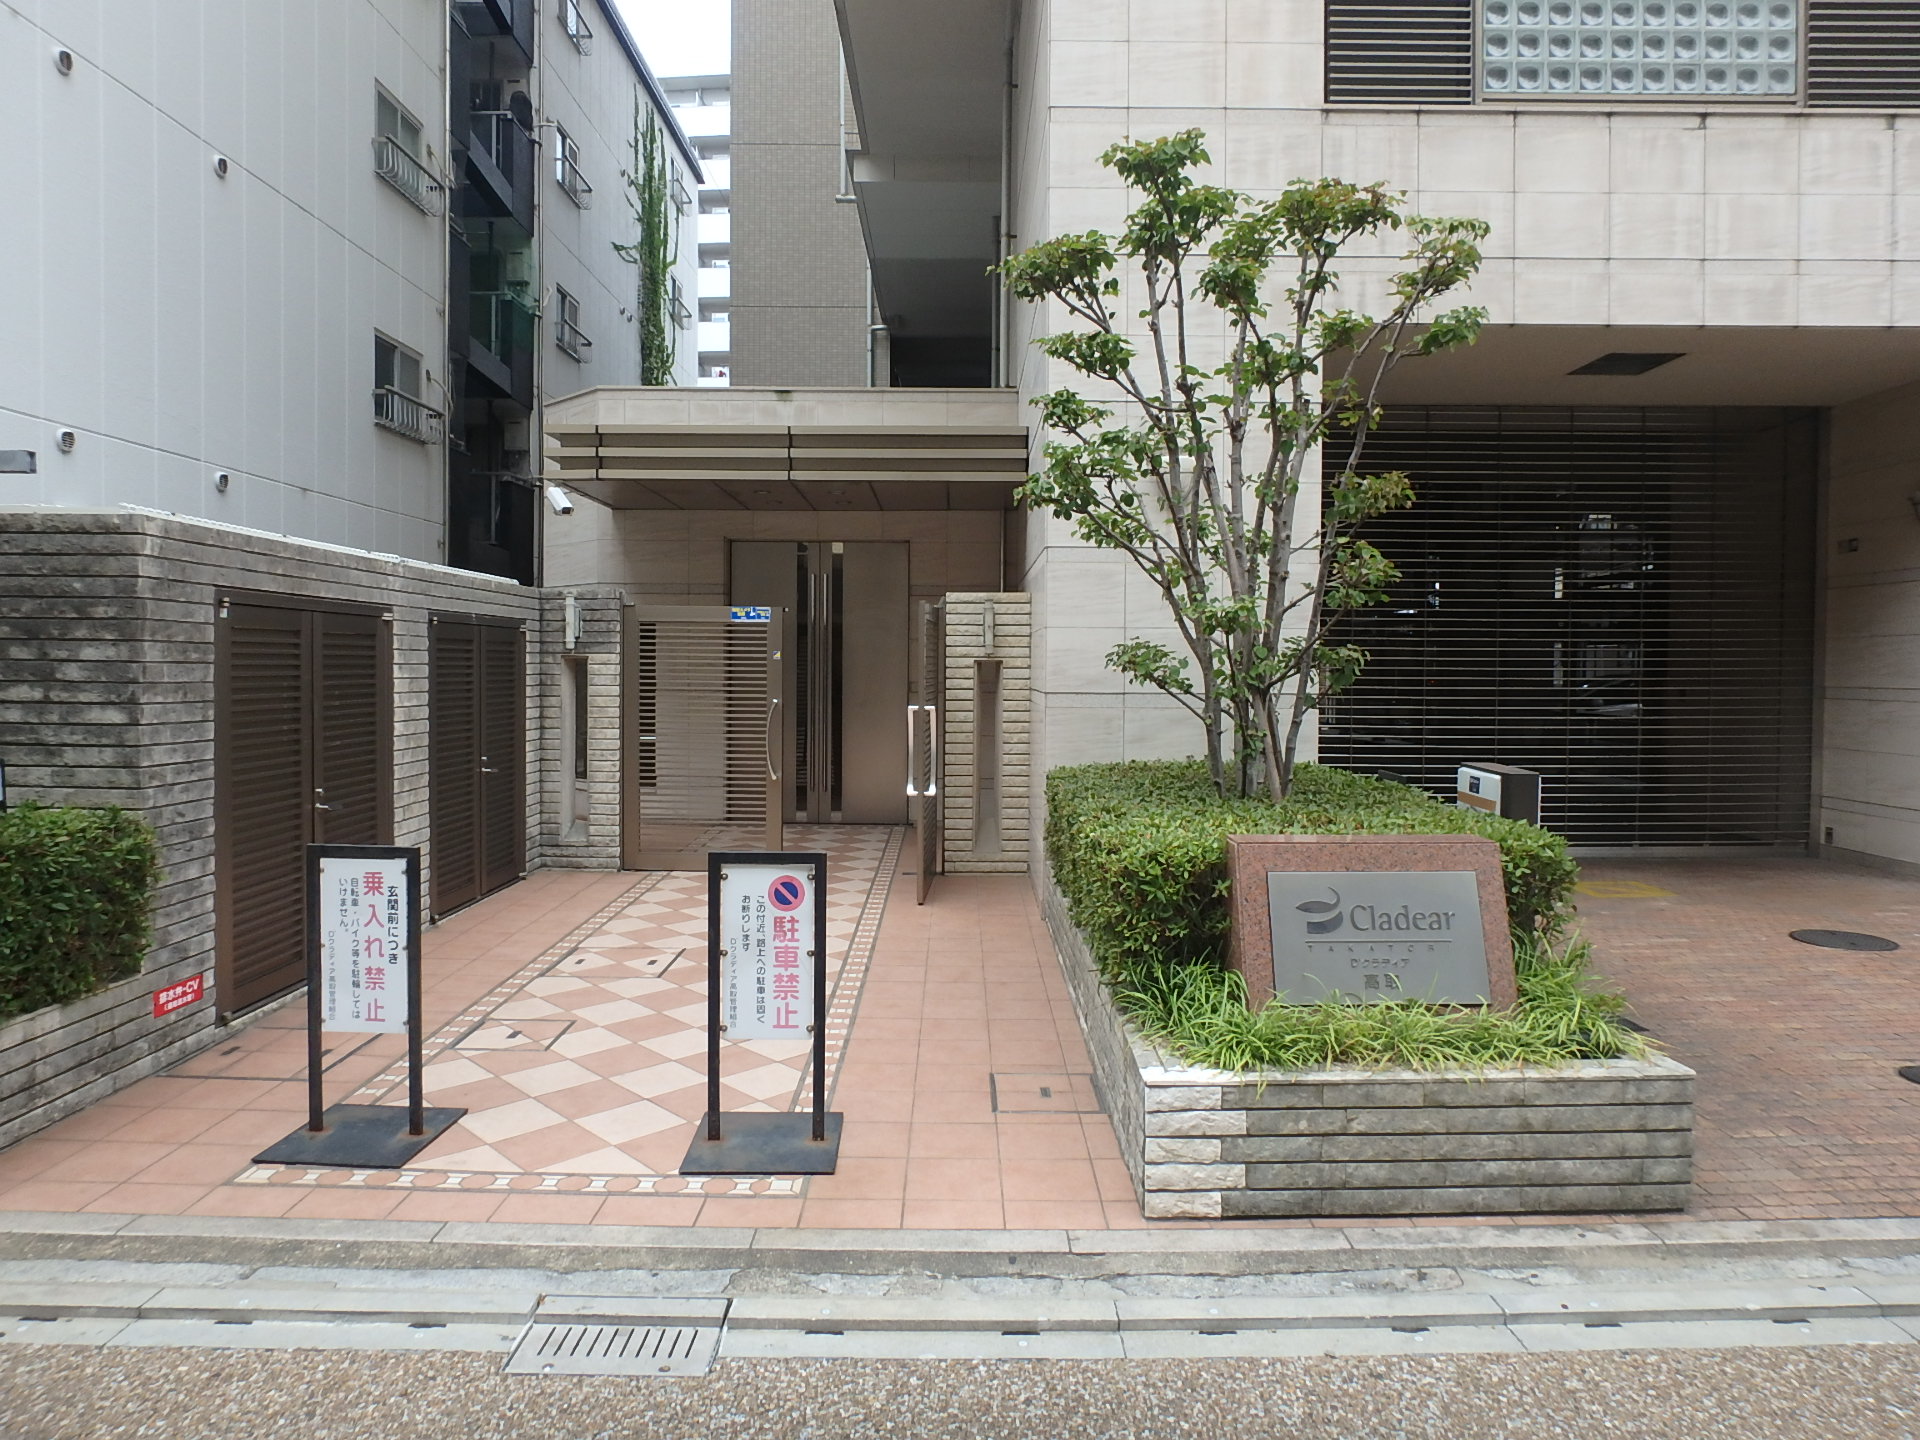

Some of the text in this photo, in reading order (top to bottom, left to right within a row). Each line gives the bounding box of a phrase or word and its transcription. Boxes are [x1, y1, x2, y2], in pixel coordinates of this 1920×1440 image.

[363, 871, 385, 1022] 乗入れ禁止
[387, 885, 398, 964] 玄関前につき
[741, 894, 751, 952] お断りします
[1350, 904, 1456, 932] Cladear
[756, 895, 766, 1024] この付近、路上への駐車は固く
[773, 916, 799, 1029] 駐車禁止
[1364, 973, 1401, 990] 高取
